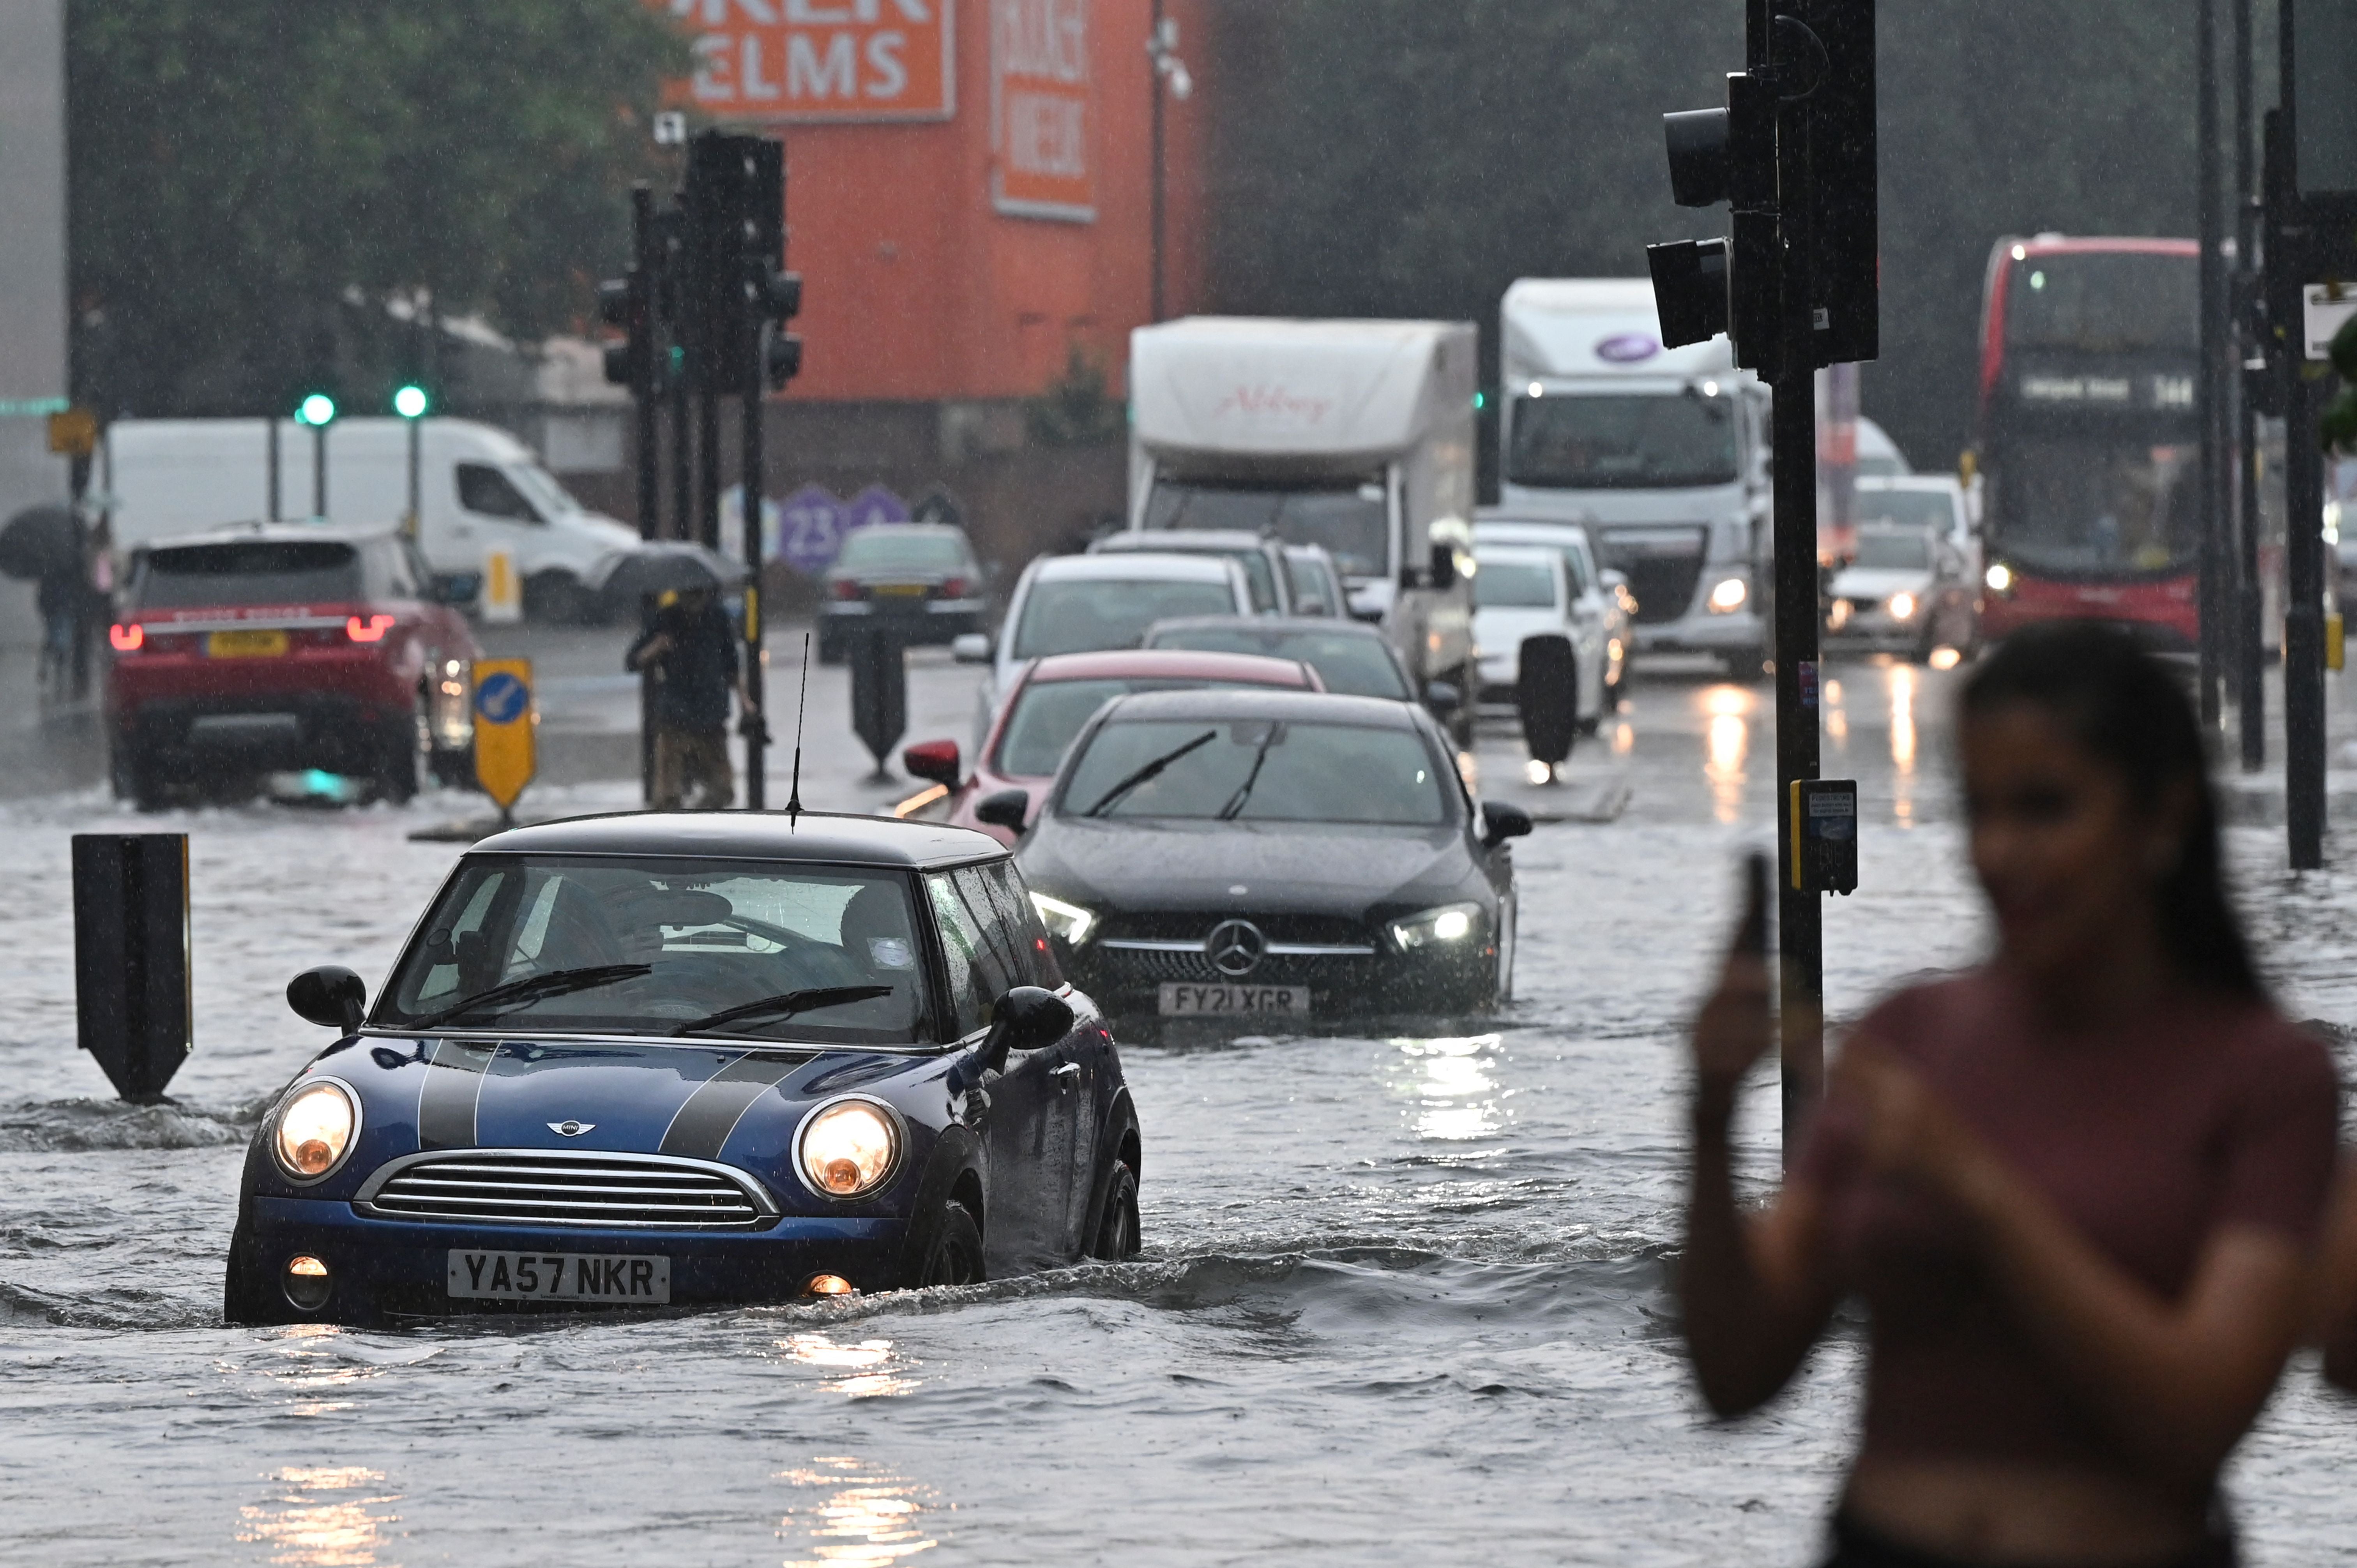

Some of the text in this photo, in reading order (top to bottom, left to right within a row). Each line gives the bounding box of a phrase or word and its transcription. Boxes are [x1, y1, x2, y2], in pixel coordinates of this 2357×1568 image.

[693, 30, 908, 100] ELMS
[1176, 986, 1292, 1012] FY21 XGR
[465, 1254, 653, 1296] YA57 NKR
